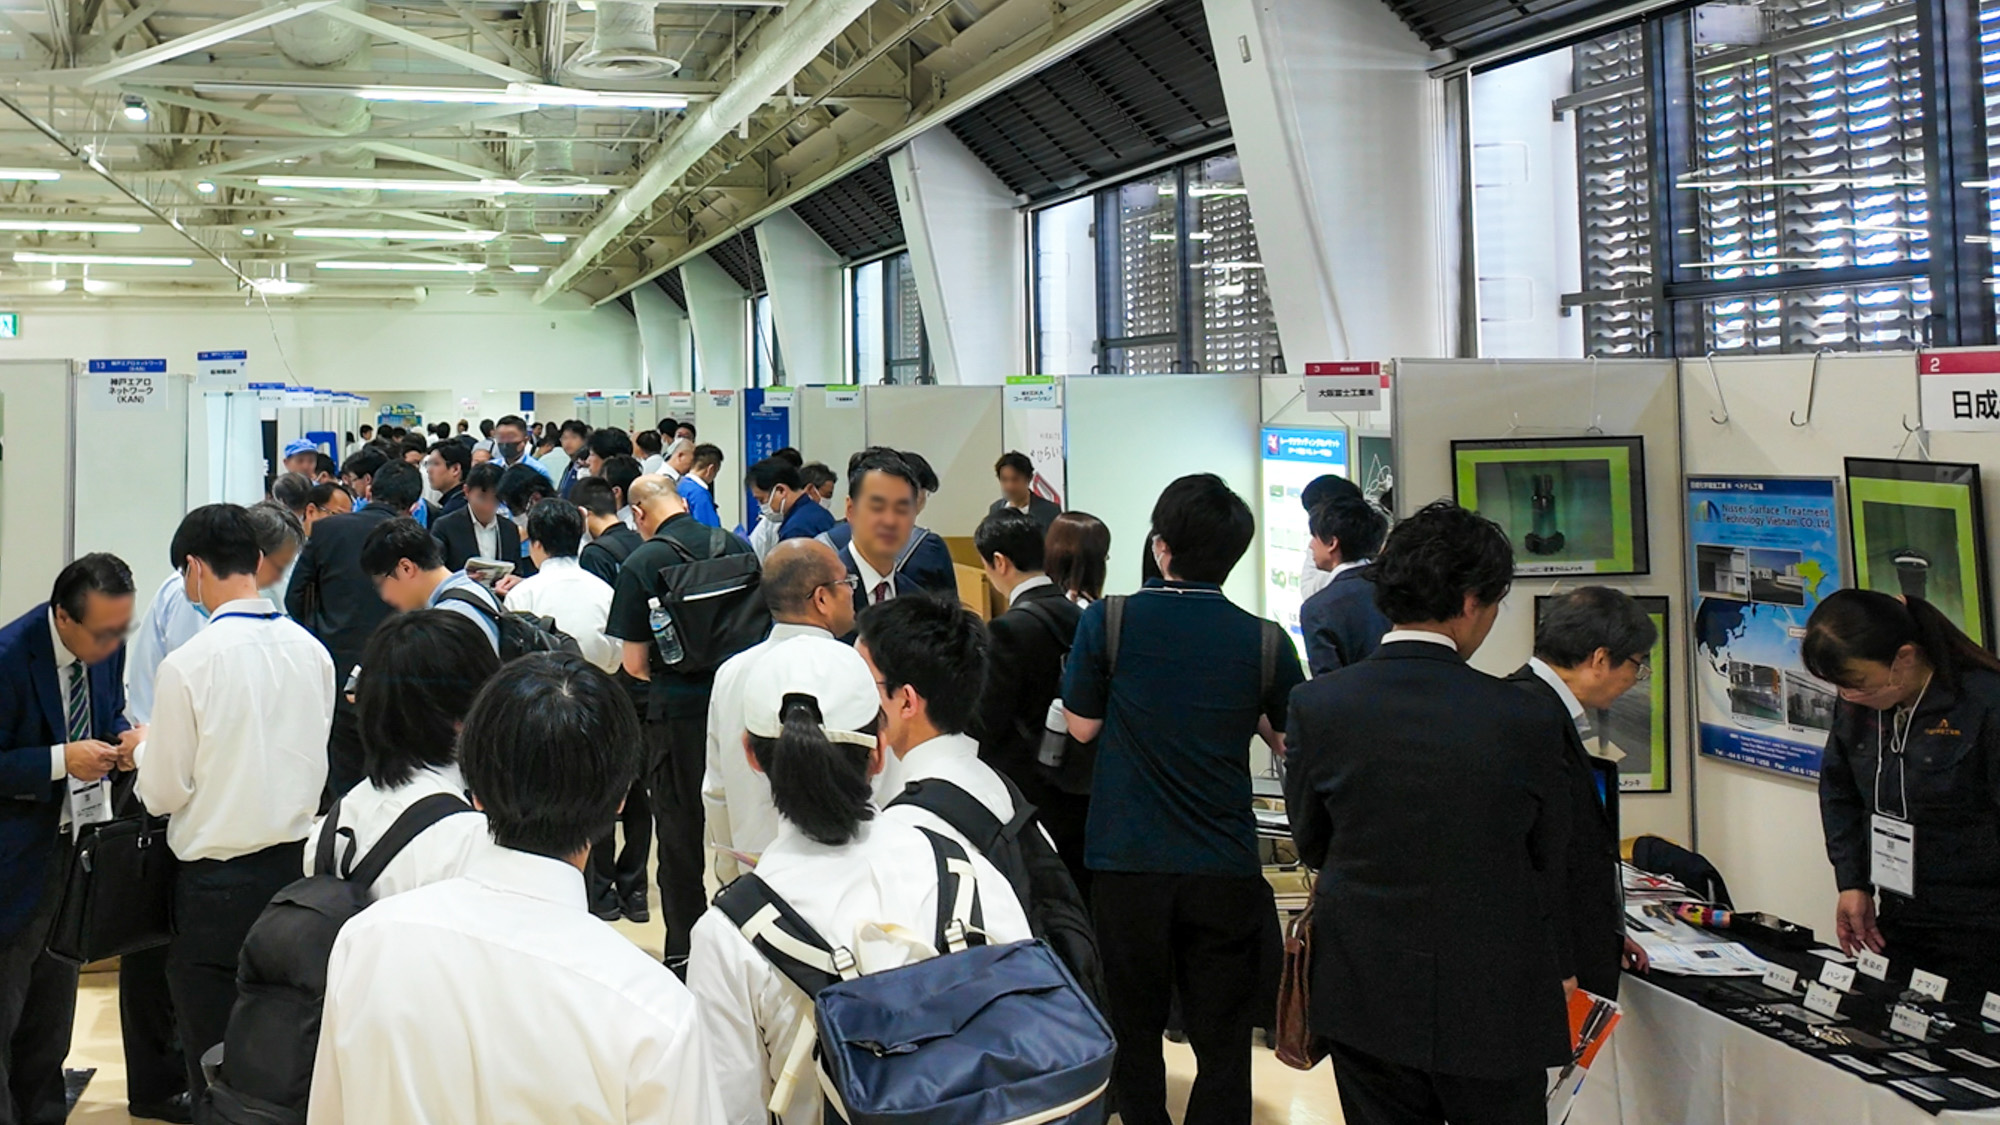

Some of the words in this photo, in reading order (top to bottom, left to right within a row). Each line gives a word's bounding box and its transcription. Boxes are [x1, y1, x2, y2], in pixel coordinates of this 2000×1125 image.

[96, 361, 106, 370] 13
[1313, 365, 1320, 373] 3
[1930, 357, 1940, 373] 2
[110, 378, 152, 386] 神戸エアロ
[108, 387, 154, 395] ネットワーク
[117, 396, 145, 404] (KAN)
[1722, 503, 1746, 513] Nissei
[1749, 504, 1780, 514] Surface
[1783, 505, 1829, 517] Treatment
[1722, 513, 1764, 526] Technology
[1766, 516, 1798, 526] Vietnam
[1826, 970, 1849, 983] ハンダ
[1915, 978, 1940, 993] ナマリ
[1810, 994, 1835, 1008] ニッケル
